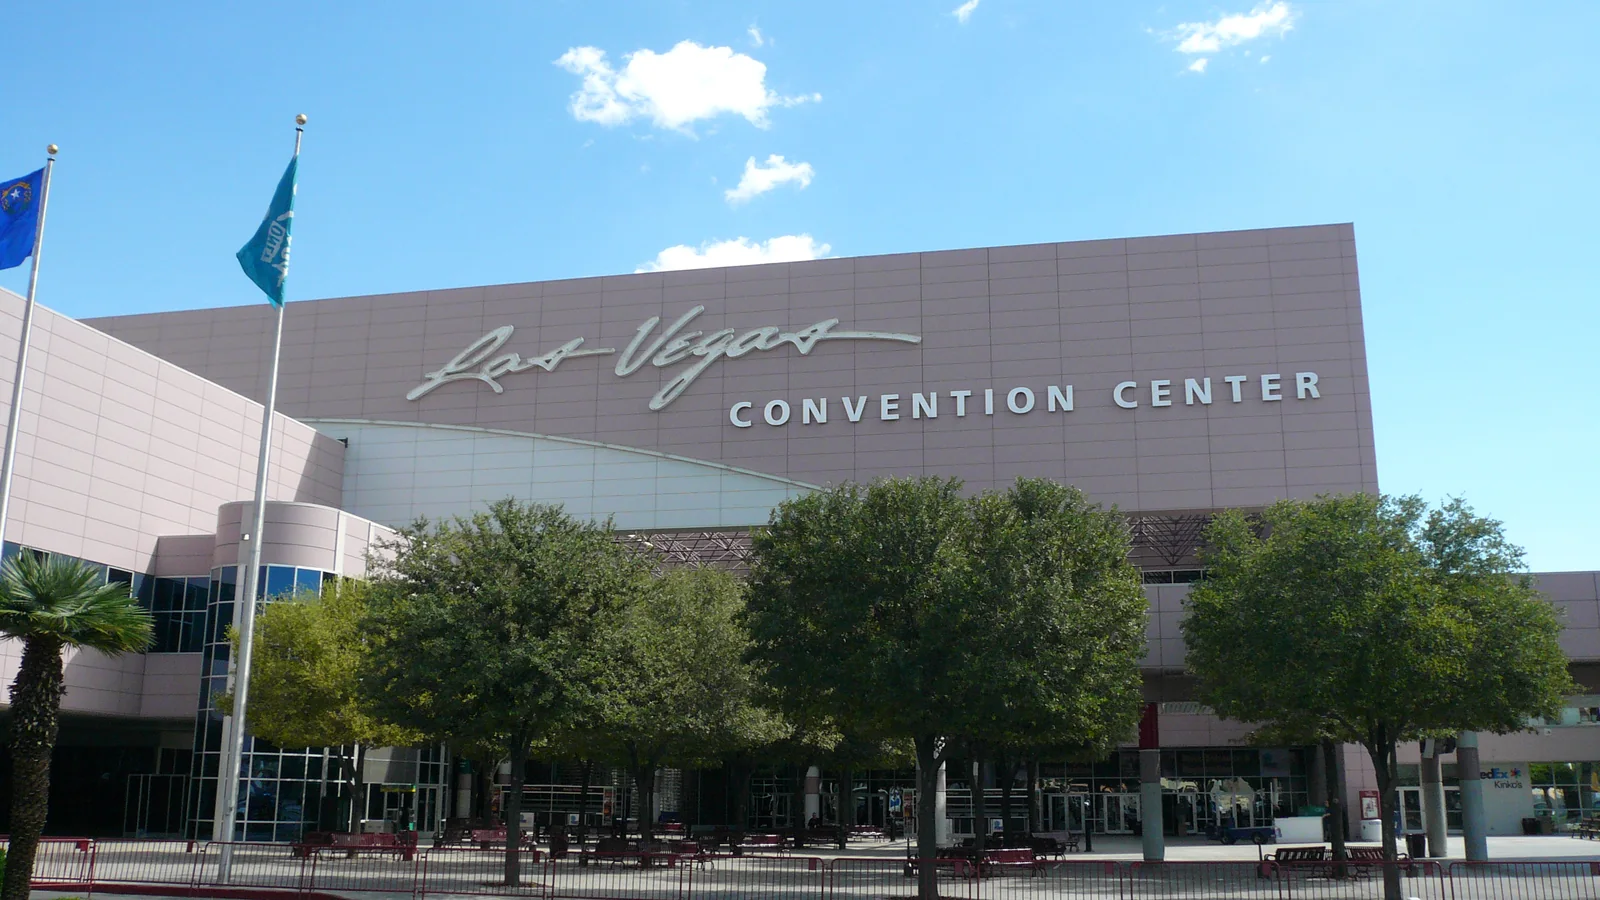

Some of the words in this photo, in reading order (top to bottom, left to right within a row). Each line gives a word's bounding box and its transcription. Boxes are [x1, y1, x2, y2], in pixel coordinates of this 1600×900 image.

[406, 325, 616, 400] Las
[615, 302, 922, 411] Vegas
[729, 385, 1075, 428] CONVENTION
[1113, 372, 1322, 409] CENTER
[1480, 768, 1508, 779] edEx
[1494, 781, 1523, 789] Kinko's
